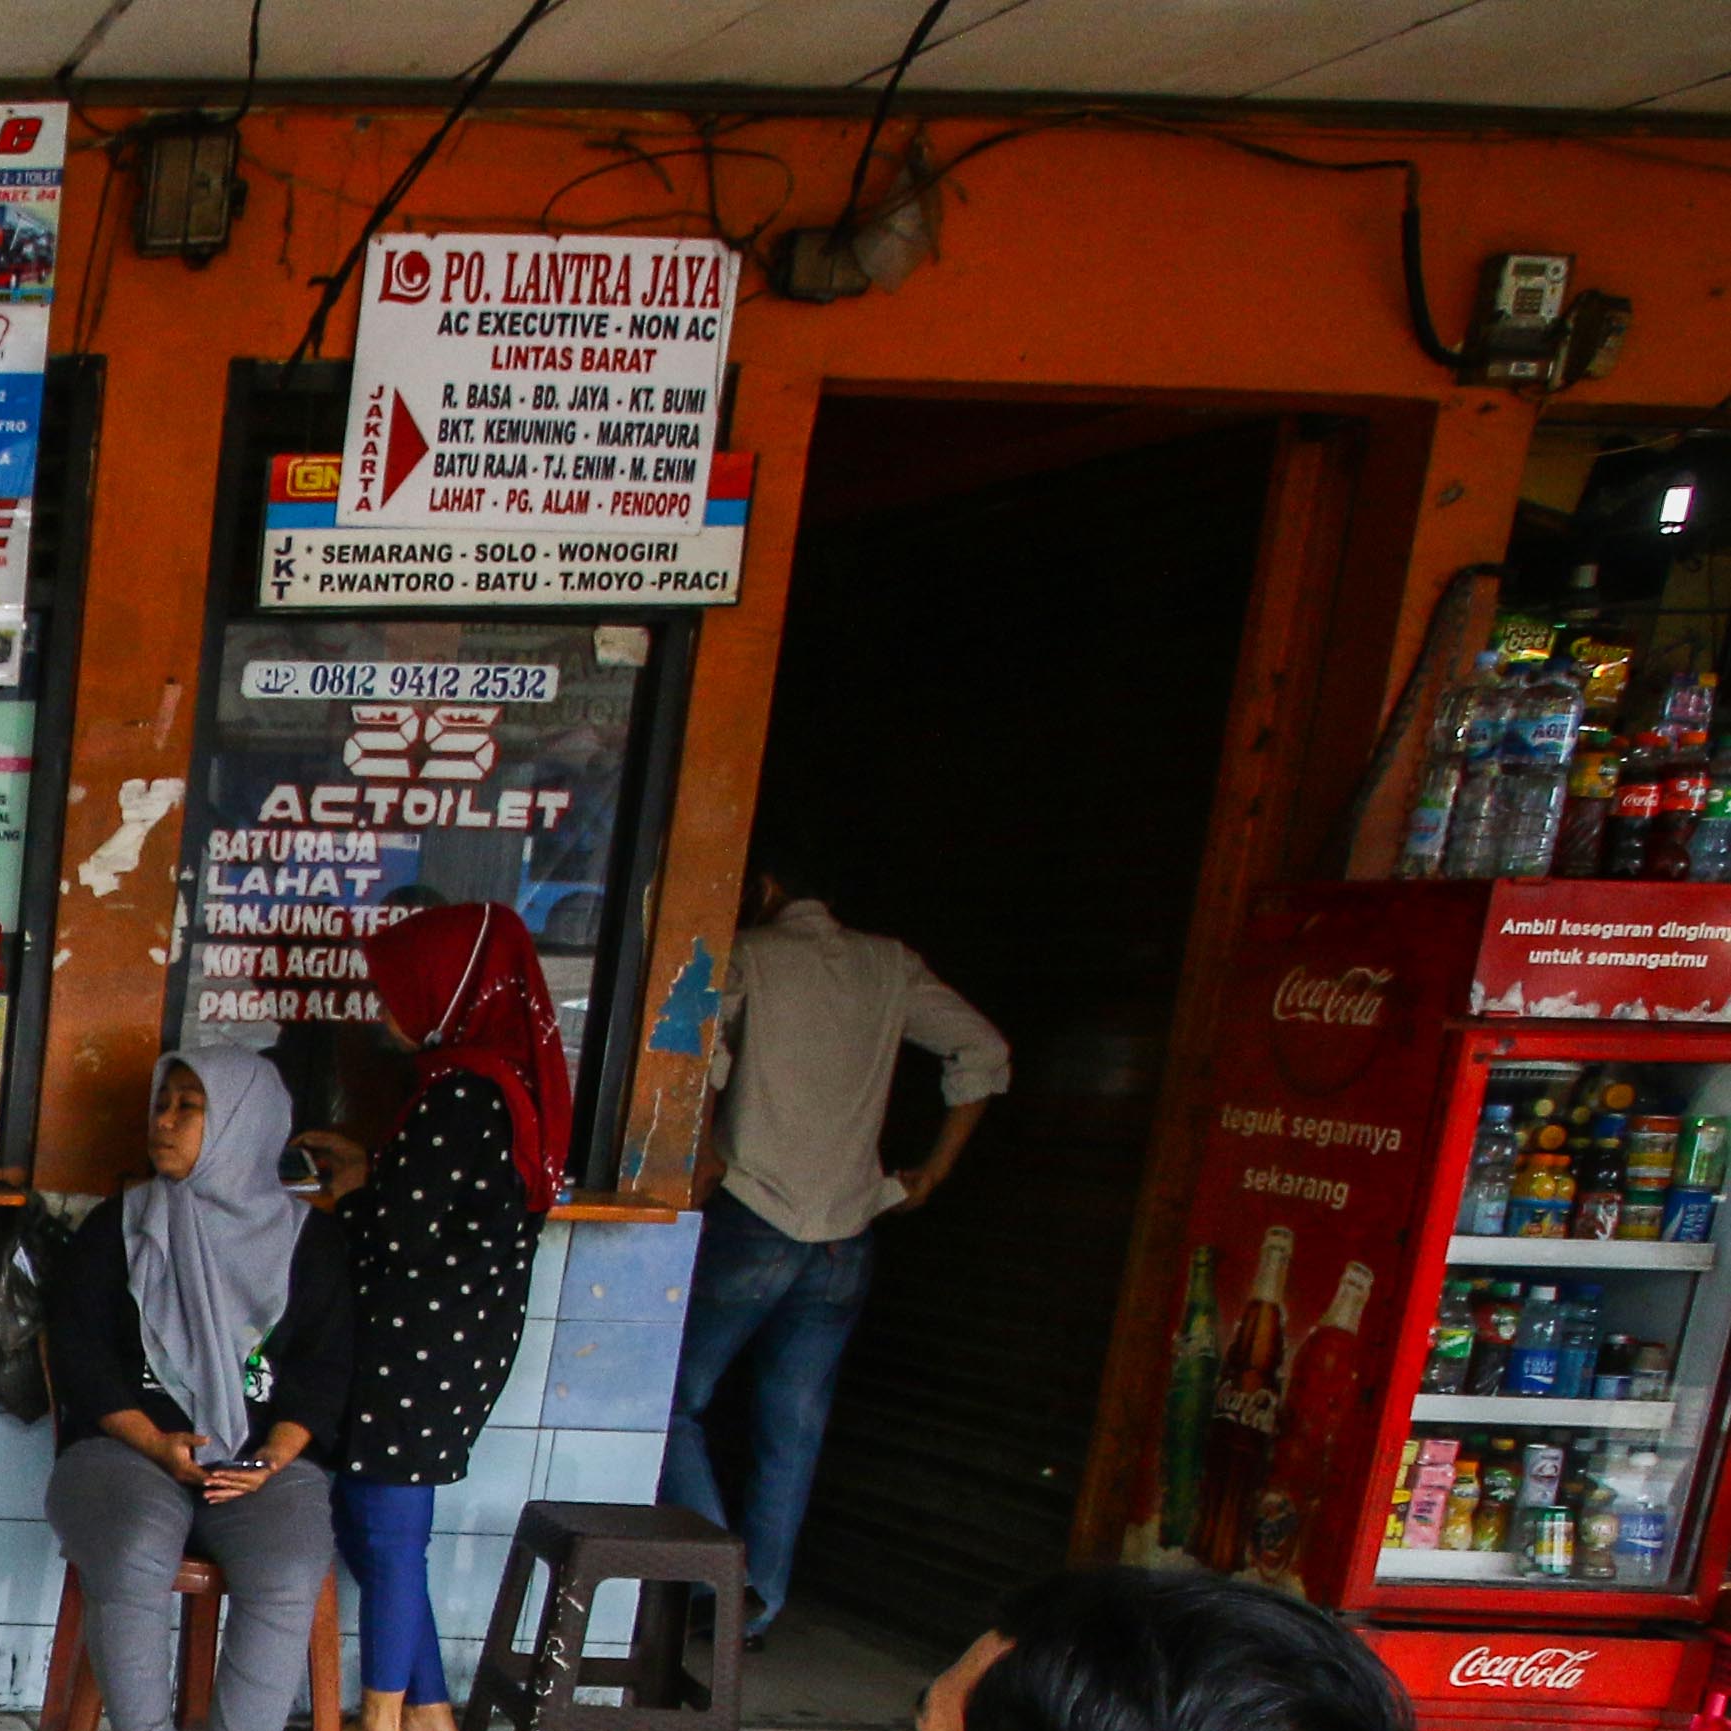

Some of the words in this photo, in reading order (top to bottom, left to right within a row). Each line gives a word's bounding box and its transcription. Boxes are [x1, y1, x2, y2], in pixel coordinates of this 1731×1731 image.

[440, 251, 492, 305] PO.
[501, 251, 632, 306] LANTRA
[641, 252, 722, 310] JAYA
[437, 312, 469, 337] AC
[477, 311, 609, 339] EXECUTIVE
[629, 315, 679, 341] NON
[684, 315, 716, 341] AC
[491, 346, 577, 373] LINTAS
[581, 348, 657, 374] BARAT
[442, 385, 459, 409] R.
[466, 385, 512, 411] BASA
[533, 386, 560, 411] BD.
[567, 386, 610, 412] JAYA
[630, 387, 656, 413] KT.
[662, 388, 706, 413] BUMI
[438, 419, 475, 445] BKT.
[484, 420, 578, 446] KEMUNING
[597, 422, 700, 449] MARTAPURA
[434, 454, 481, 479] BATU
[484, 454, 528, 480] RAJA
[543, 456, 567, 482] TJ.
[572, 456, 616, 482] ENIM
[630, 457, 648, 483] M.
[653, 458, 696, 483] ENIM
[430, 488, 485, 513] LAHAT
[506, 489, 533, 515] PG.
[542, 490, 590, 515] ALAM
[609, 491, 690, 518] PENDOPO
[322, 542, 454, 565] SEMARANG
[474, 542, 537, 564] SOLO
[559, 542, 679, 564] WONOGIRI
[319, 573, 455, 595] P.WANTORO
[476, 573, 538, 593] BATU
[560, 573, 644, 592] T.MOYO
[308, 665, 374, 697] 0812
[389, 665, 460, 698] 9412
[470, 666, 547, 701] 2532
[206, 865, 382, 896] LAHAT
[204, 903, 343, 936] TANJUNG
[1500, 918, 1557, 936] Ambil
[1560, 919, 1652, 940] kesegaran
[202, 944, 280, 978] KOTA
[285, 945, 369, 979] AGUN
[1529, 947, 1582, 965] untuk
[1587, 951, 1708, 969] semangatmu
[198, 990, 300, 1021] PAGAR
[1291, 1115, 1402, 1155] segarnya
[1242, 1165, 1350, 1210] sekarang
[1448, 1645, 1599, 1690] Coca-Cola
